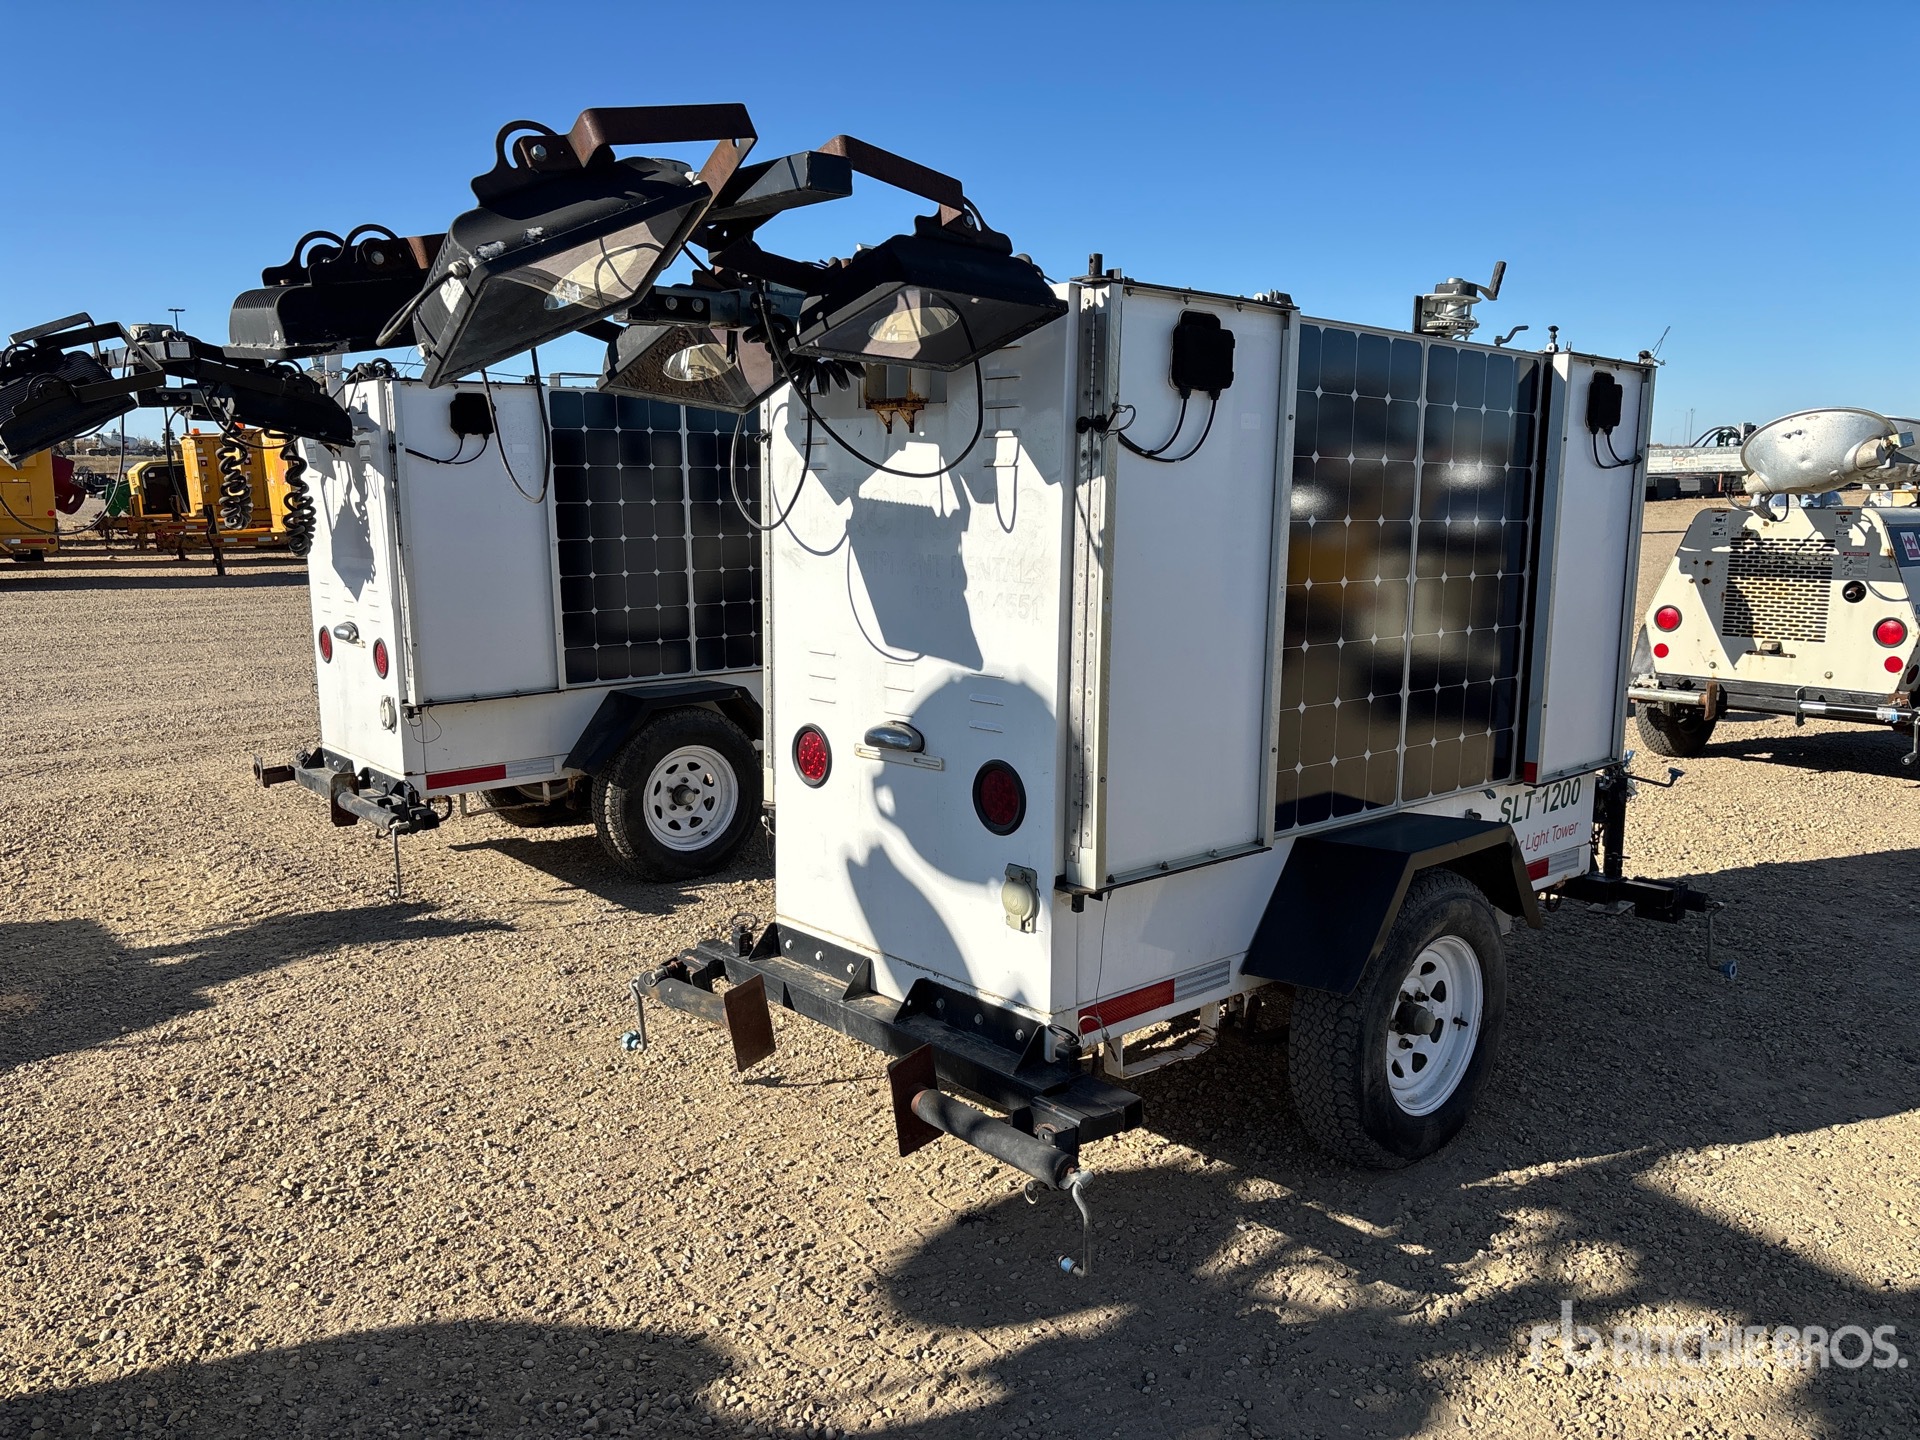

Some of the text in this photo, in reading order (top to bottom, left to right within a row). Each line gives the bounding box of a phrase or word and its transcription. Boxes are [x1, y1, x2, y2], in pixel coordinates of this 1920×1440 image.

[1498, 777, 1581, 824] SLT 1200
[1525, 828, 1550, 851] Light
[1552, 822, 1579, 841] Tower
